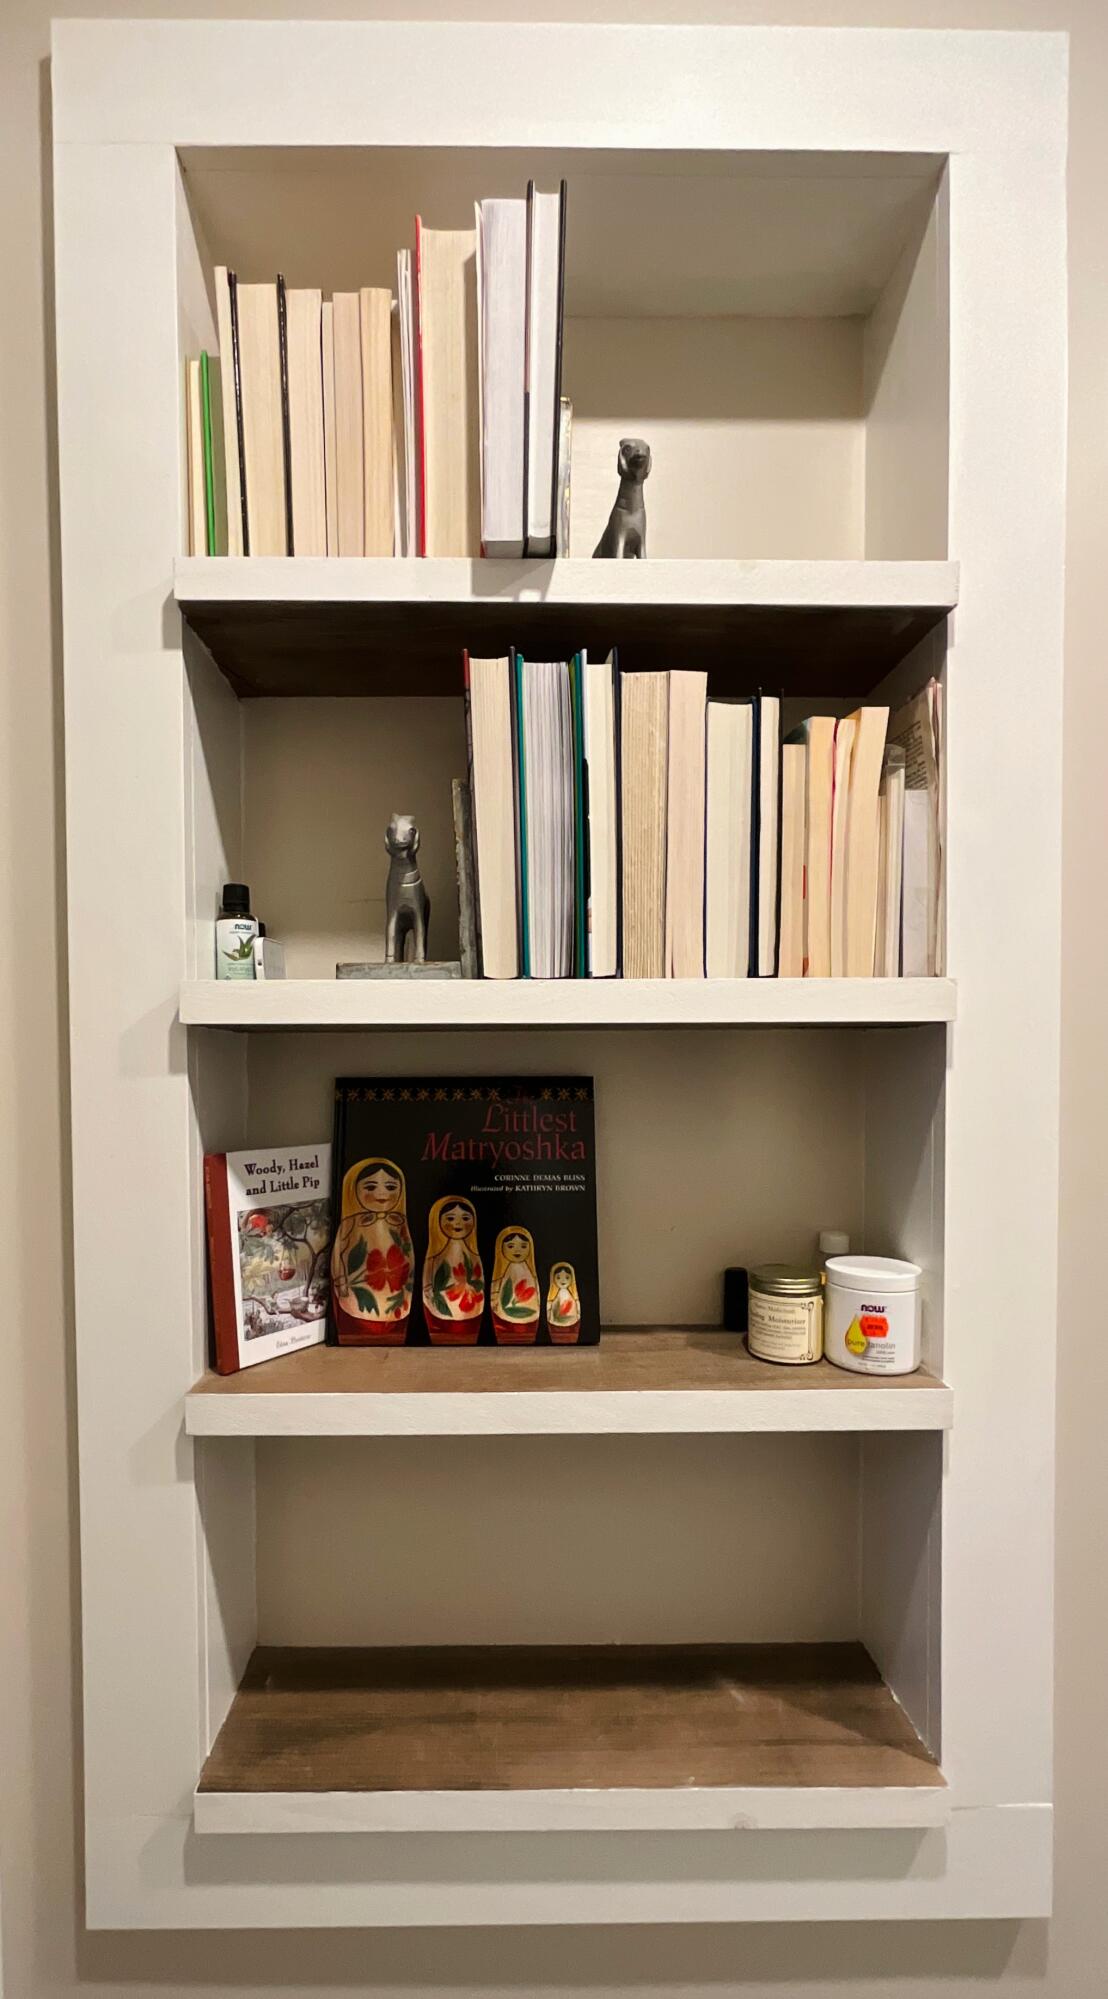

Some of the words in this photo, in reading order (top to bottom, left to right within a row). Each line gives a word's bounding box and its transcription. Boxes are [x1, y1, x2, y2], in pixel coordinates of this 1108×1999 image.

[481, 1103, 577, 1133] Littlest
[421, 1130, 586, 1168] Matryoshka
[244, 1159, 286, 1176] Woody,
[289, 1154, 319, 1171] Hazel
[245, 1180, 267, 1196] and
[270, 1176, 300, 1193] Little
[302, 1175, 320, 1190] Pip
[494, 1174, 530, 1182] CORINNE
[533, 1174, 562, 1182] DEMAS
[563, 1174, 586, 1182] BLISS
[515, 1184, 553, 1192] KATHRYN
[555, 1184, 586, 1192] BROWN
[860, 1304, 885, 1313] now
